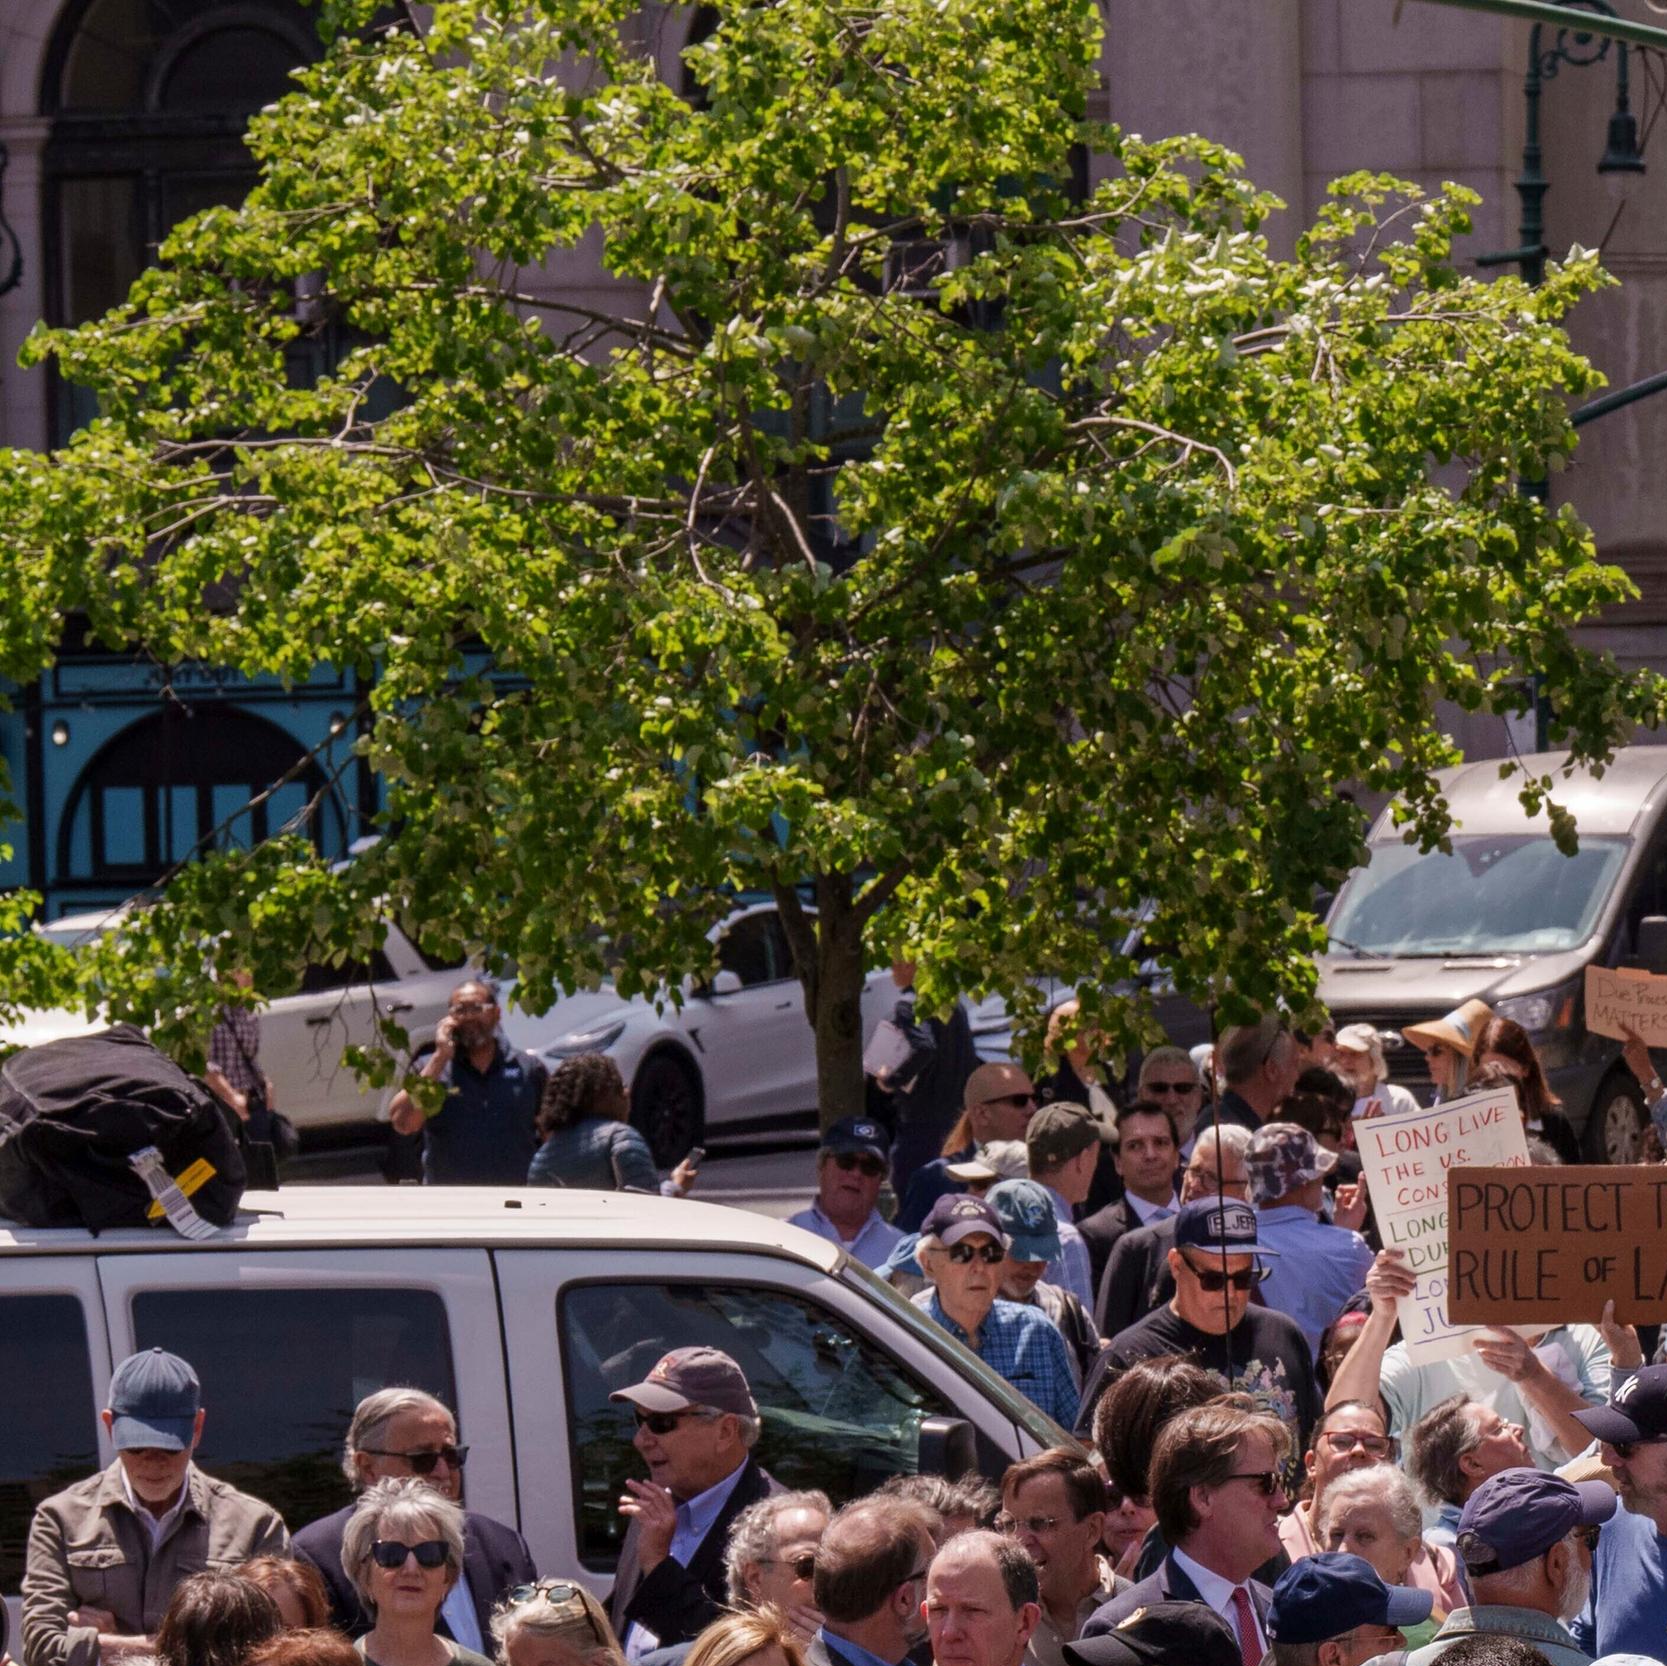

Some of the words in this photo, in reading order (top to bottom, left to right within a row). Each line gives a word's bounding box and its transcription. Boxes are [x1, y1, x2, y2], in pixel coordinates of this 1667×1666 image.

[1375, 1121, 1449, 1158] LONG
[1458, 1105, 1510, 1136] LIVE
[1381, 1161, 1425, 1186] THE
[1439, 1148, 1472, 1170] U.S.
[1456, 1181, 1633, 1233] PROTECT
[1455, 1248, 1560, 1302] RULE
[1583, 1256, 1617, 1284] OF
